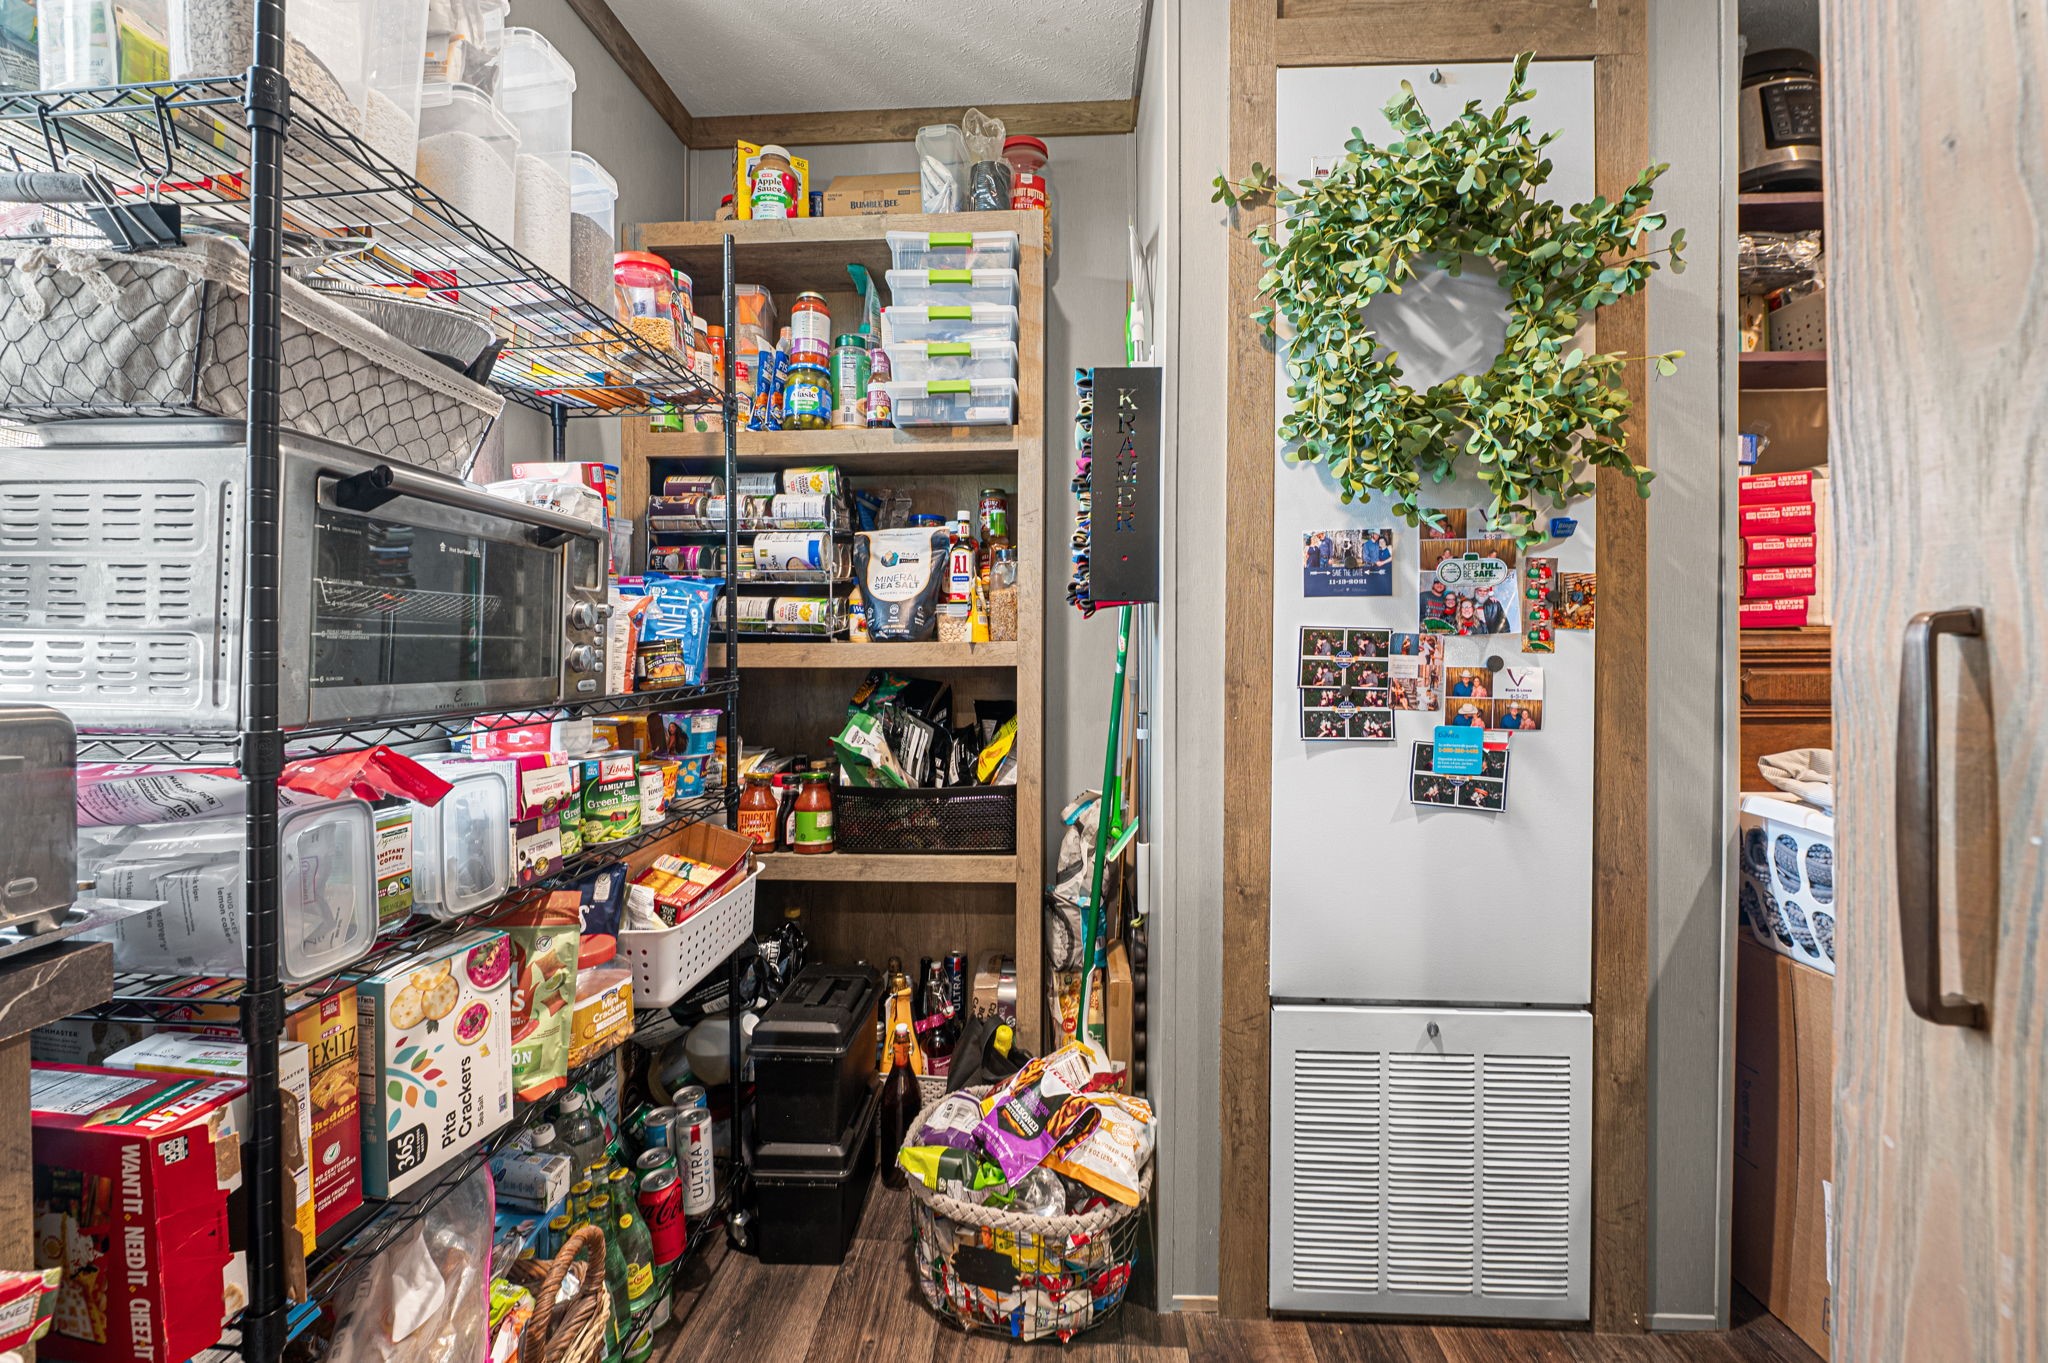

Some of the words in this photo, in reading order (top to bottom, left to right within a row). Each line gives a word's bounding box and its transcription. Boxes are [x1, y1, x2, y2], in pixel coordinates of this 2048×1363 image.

[757, 178, 783, 189] Apple
[757, 185, 783, 193] Sauce
[850, 200, 883, 209] BUMBLE
[884, 199, 899, 208] BEE
[1114, 387, 1139, 532] KRAMER
[1332, 568, 1342, 577] SAVE
[1343, 568, 1352, 577] THE
[1463, 562, 1480, 571] KEEP
[1481, 562, 1503, 570] FULL.
[875, 573, 918, 583] MINERAL
[894, 581, 920, 589] SALT
[599, 782, 624, 792] FAMILY
[587, 796, 619, 809] Green
[740, 812, 765, 825] THICK
[377, 847, 405, 860] INSTANT
[379, 854, 403, 866] COFFEE
[217, 886, 226, 916] lemon
[953, 974, 961, 1012] ULTRA
[601, 995, 619, 1010] Mini
[592, 1000, 627, 1023] Crackers
[458, 1055, 473, 1138] Crackers
[477, 1094, 485, 1112] Salt
[477, 1111, 485, 1128] Sea
[1009, 1098, 1040, 1133] EASONED
[441, 1109, 457, 1149] Pita
[395, 1133, 415, 1171] 365
[121, 1144, 142, 1198] WANT
[324, 1156, 350, 1177] CERTIFIED
[691, 1146, 704, 1199] ULTRA
[314, 1171, 338, 1188] NTHETIC
[123, 1198, 144, 1215] IT
[124, 1226, 146, 1270] NEED
[125, 1270, 149, 1287] IT
[129, 1298, 154, 1361] CHEEZ-IT
